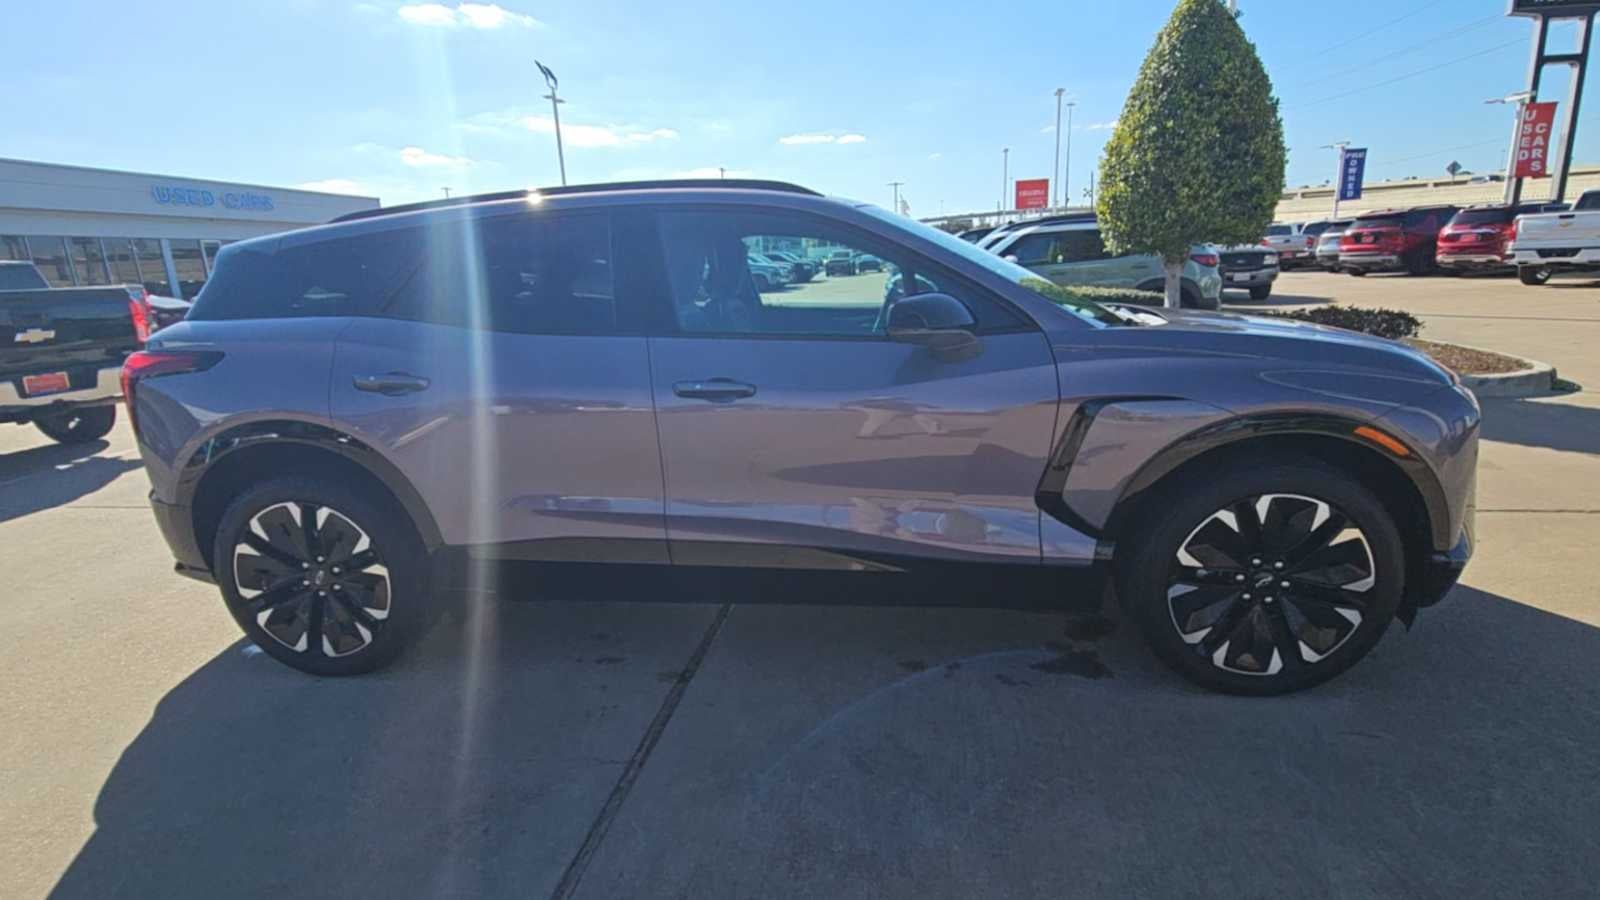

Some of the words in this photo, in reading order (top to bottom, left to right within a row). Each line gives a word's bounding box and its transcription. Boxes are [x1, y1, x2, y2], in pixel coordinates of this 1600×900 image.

[1519, 109, 1537, 161] USED
[1530, 123, 1548, 171] CARS
[152, 184, 216, 207] USED
